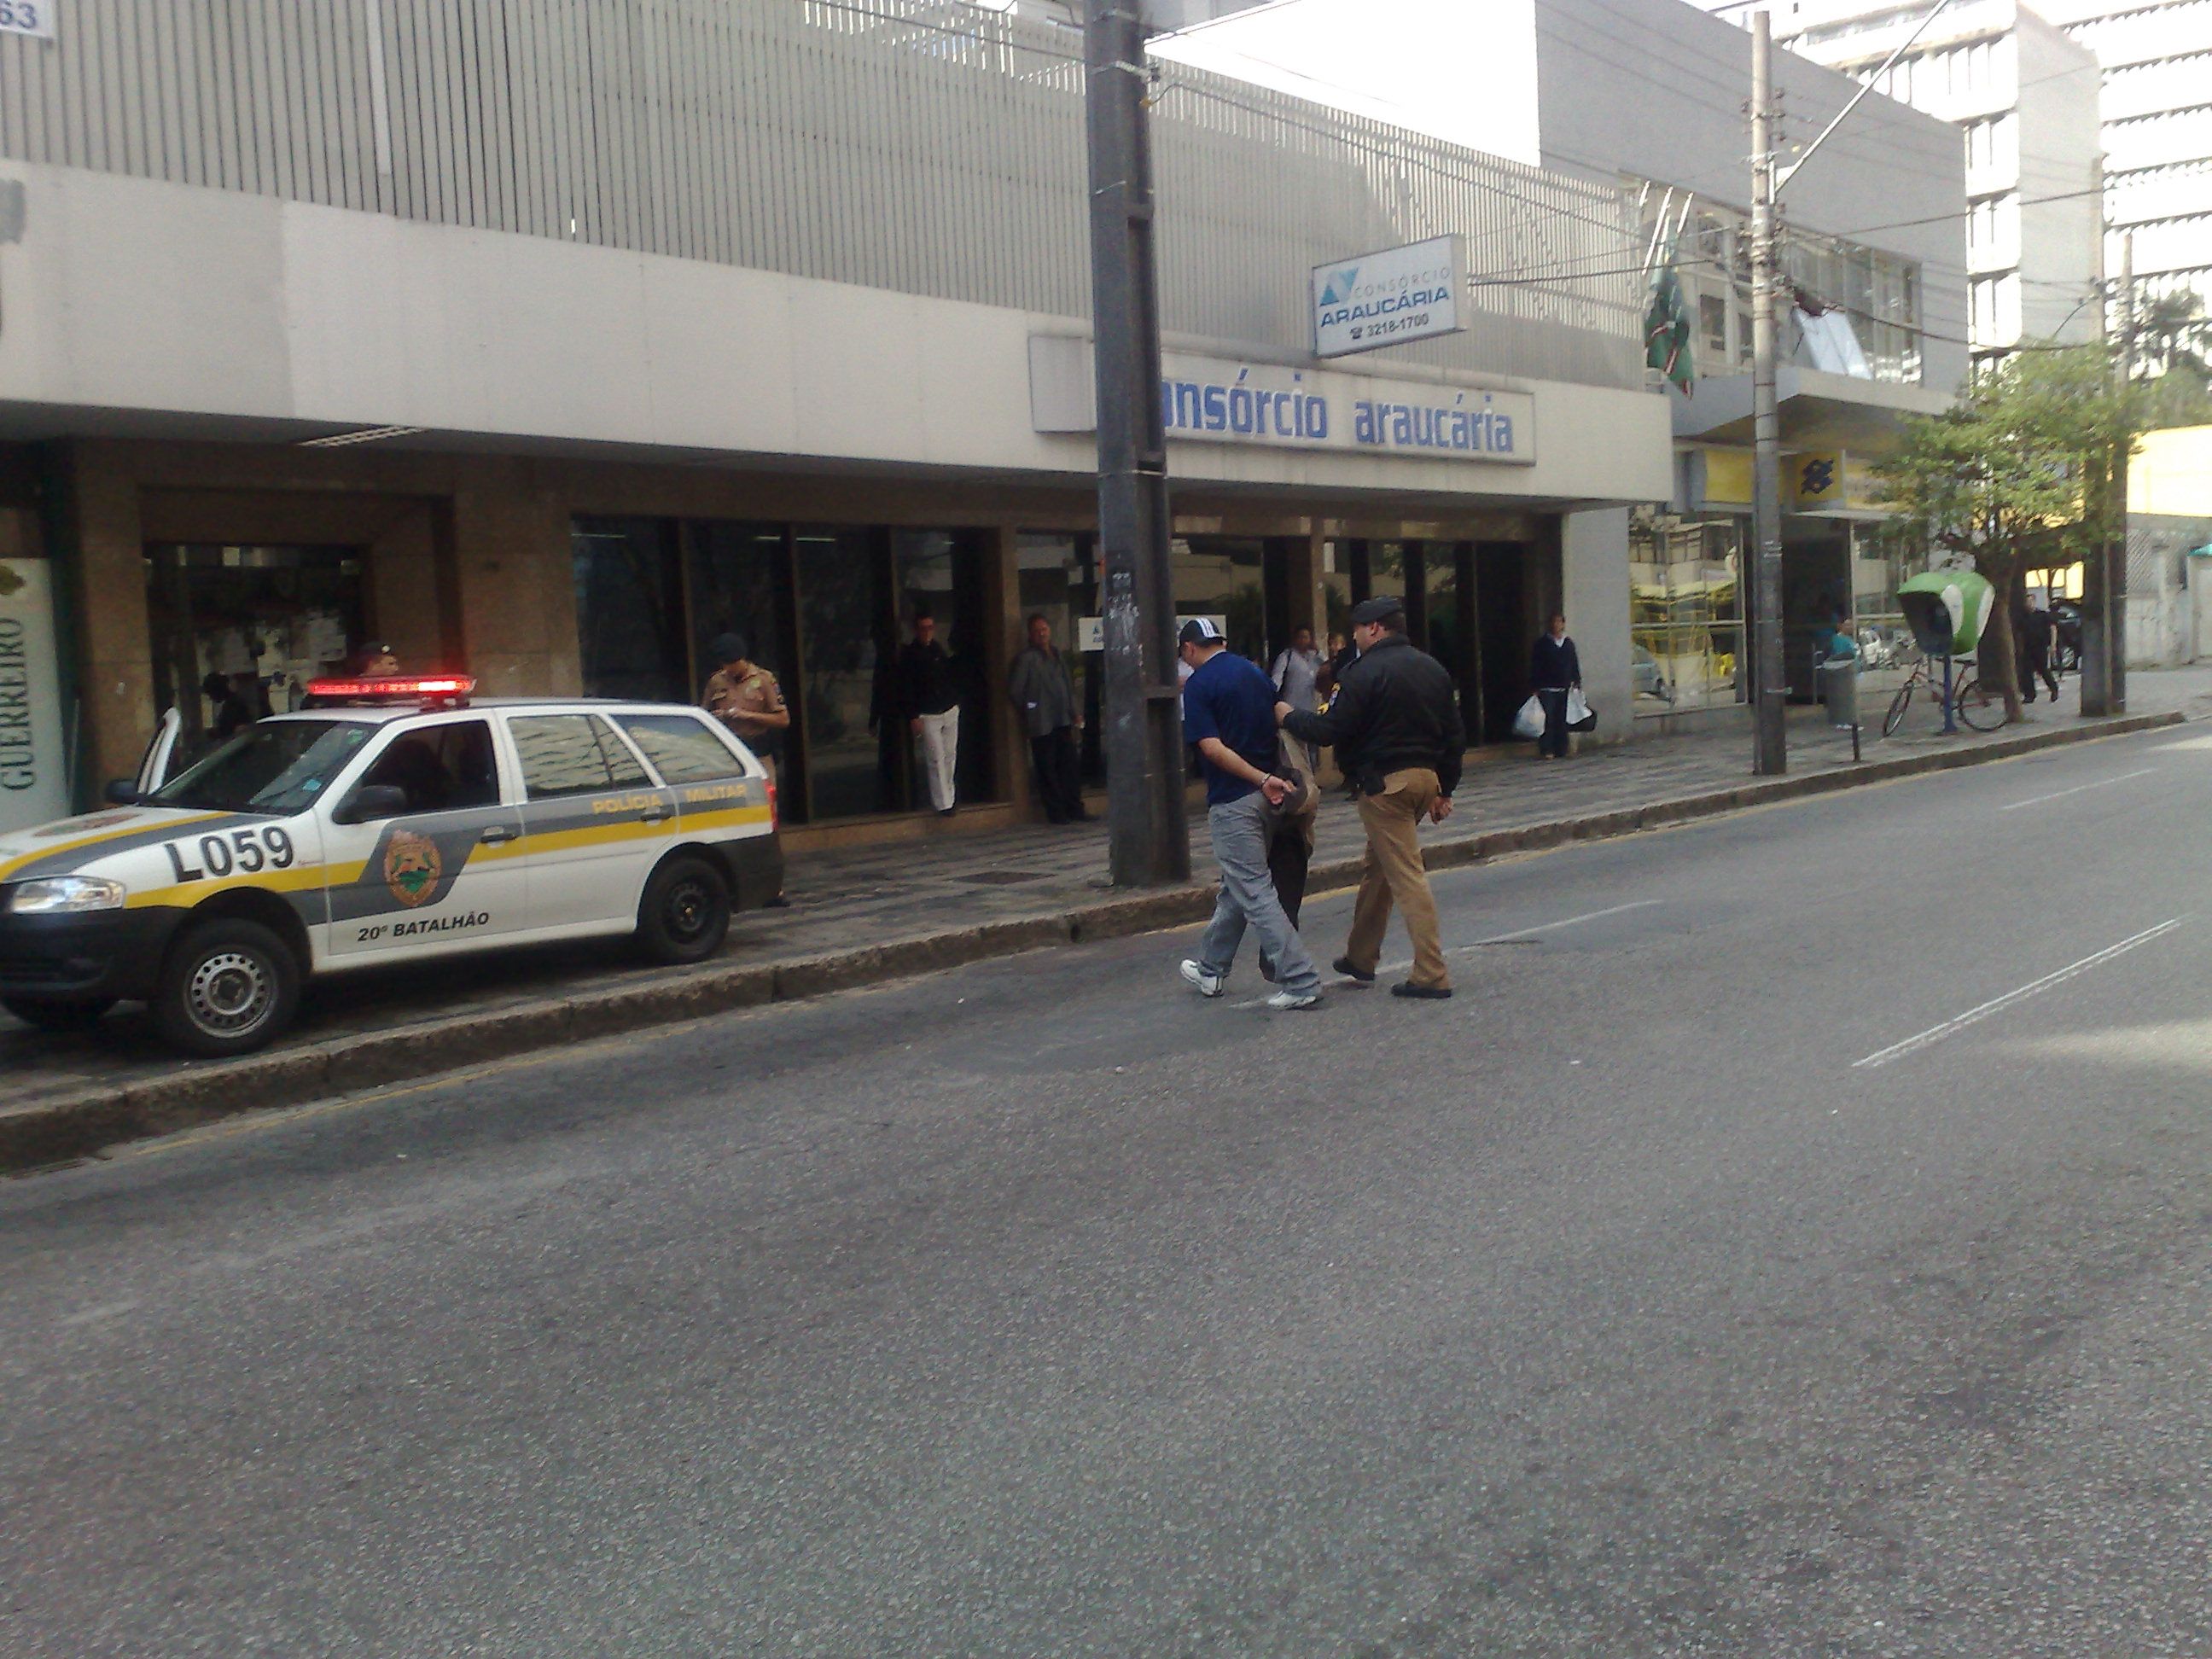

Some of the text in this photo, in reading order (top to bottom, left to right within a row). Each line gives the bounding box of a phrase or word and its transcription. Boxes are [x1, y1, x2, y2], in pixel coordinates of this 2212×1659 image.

[1354, 265, 1452, 299] CONSÓRCIO
[1320, 287, 1449, 328] ARAUCÁRIA
[1367, 313, 1429, 337] 3218-1700
[1355, 393, 1513, 452] araucária
[0, 618, 35, 790] GUERREIRO
[591, 784, 748, 814] POLÍCIA MILITAR
[164, 826, 294, 883] L059
[357, 911, 490, 942] 20º BATALHÃO
